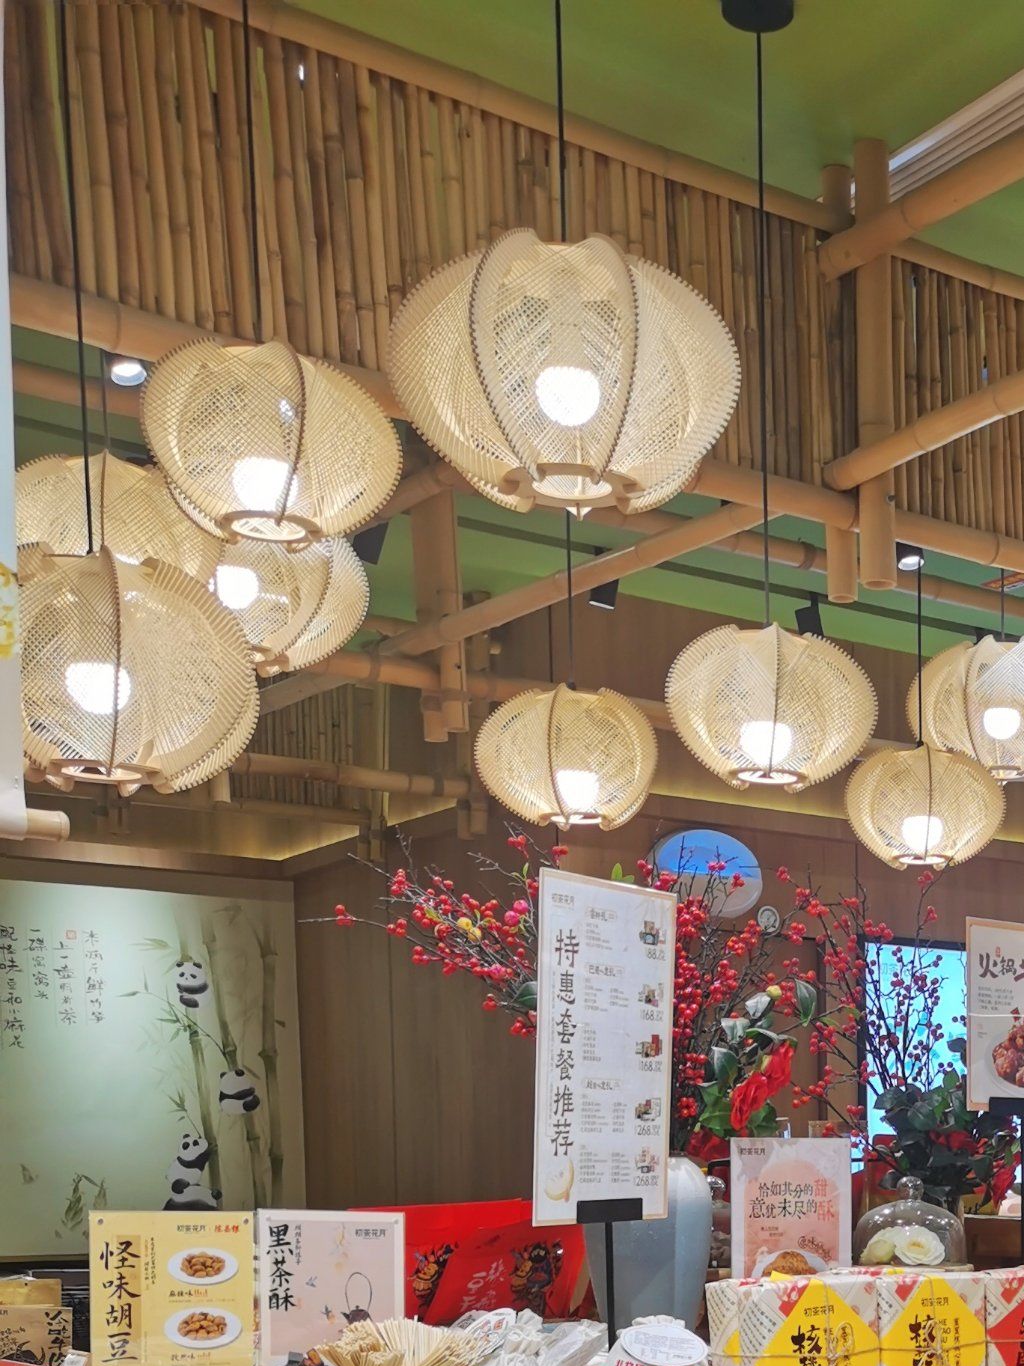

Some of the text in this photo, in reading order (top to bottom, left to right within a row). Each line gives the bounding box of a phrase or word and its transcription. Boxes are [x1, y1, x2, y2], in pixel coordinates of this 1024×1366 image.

[551, 929, 579, 1157] 特惠套餐推荐
[100, 1240, 141, 1363] 怪味胡豆
[267, 1223, 297, 1312] 黑茶酥
